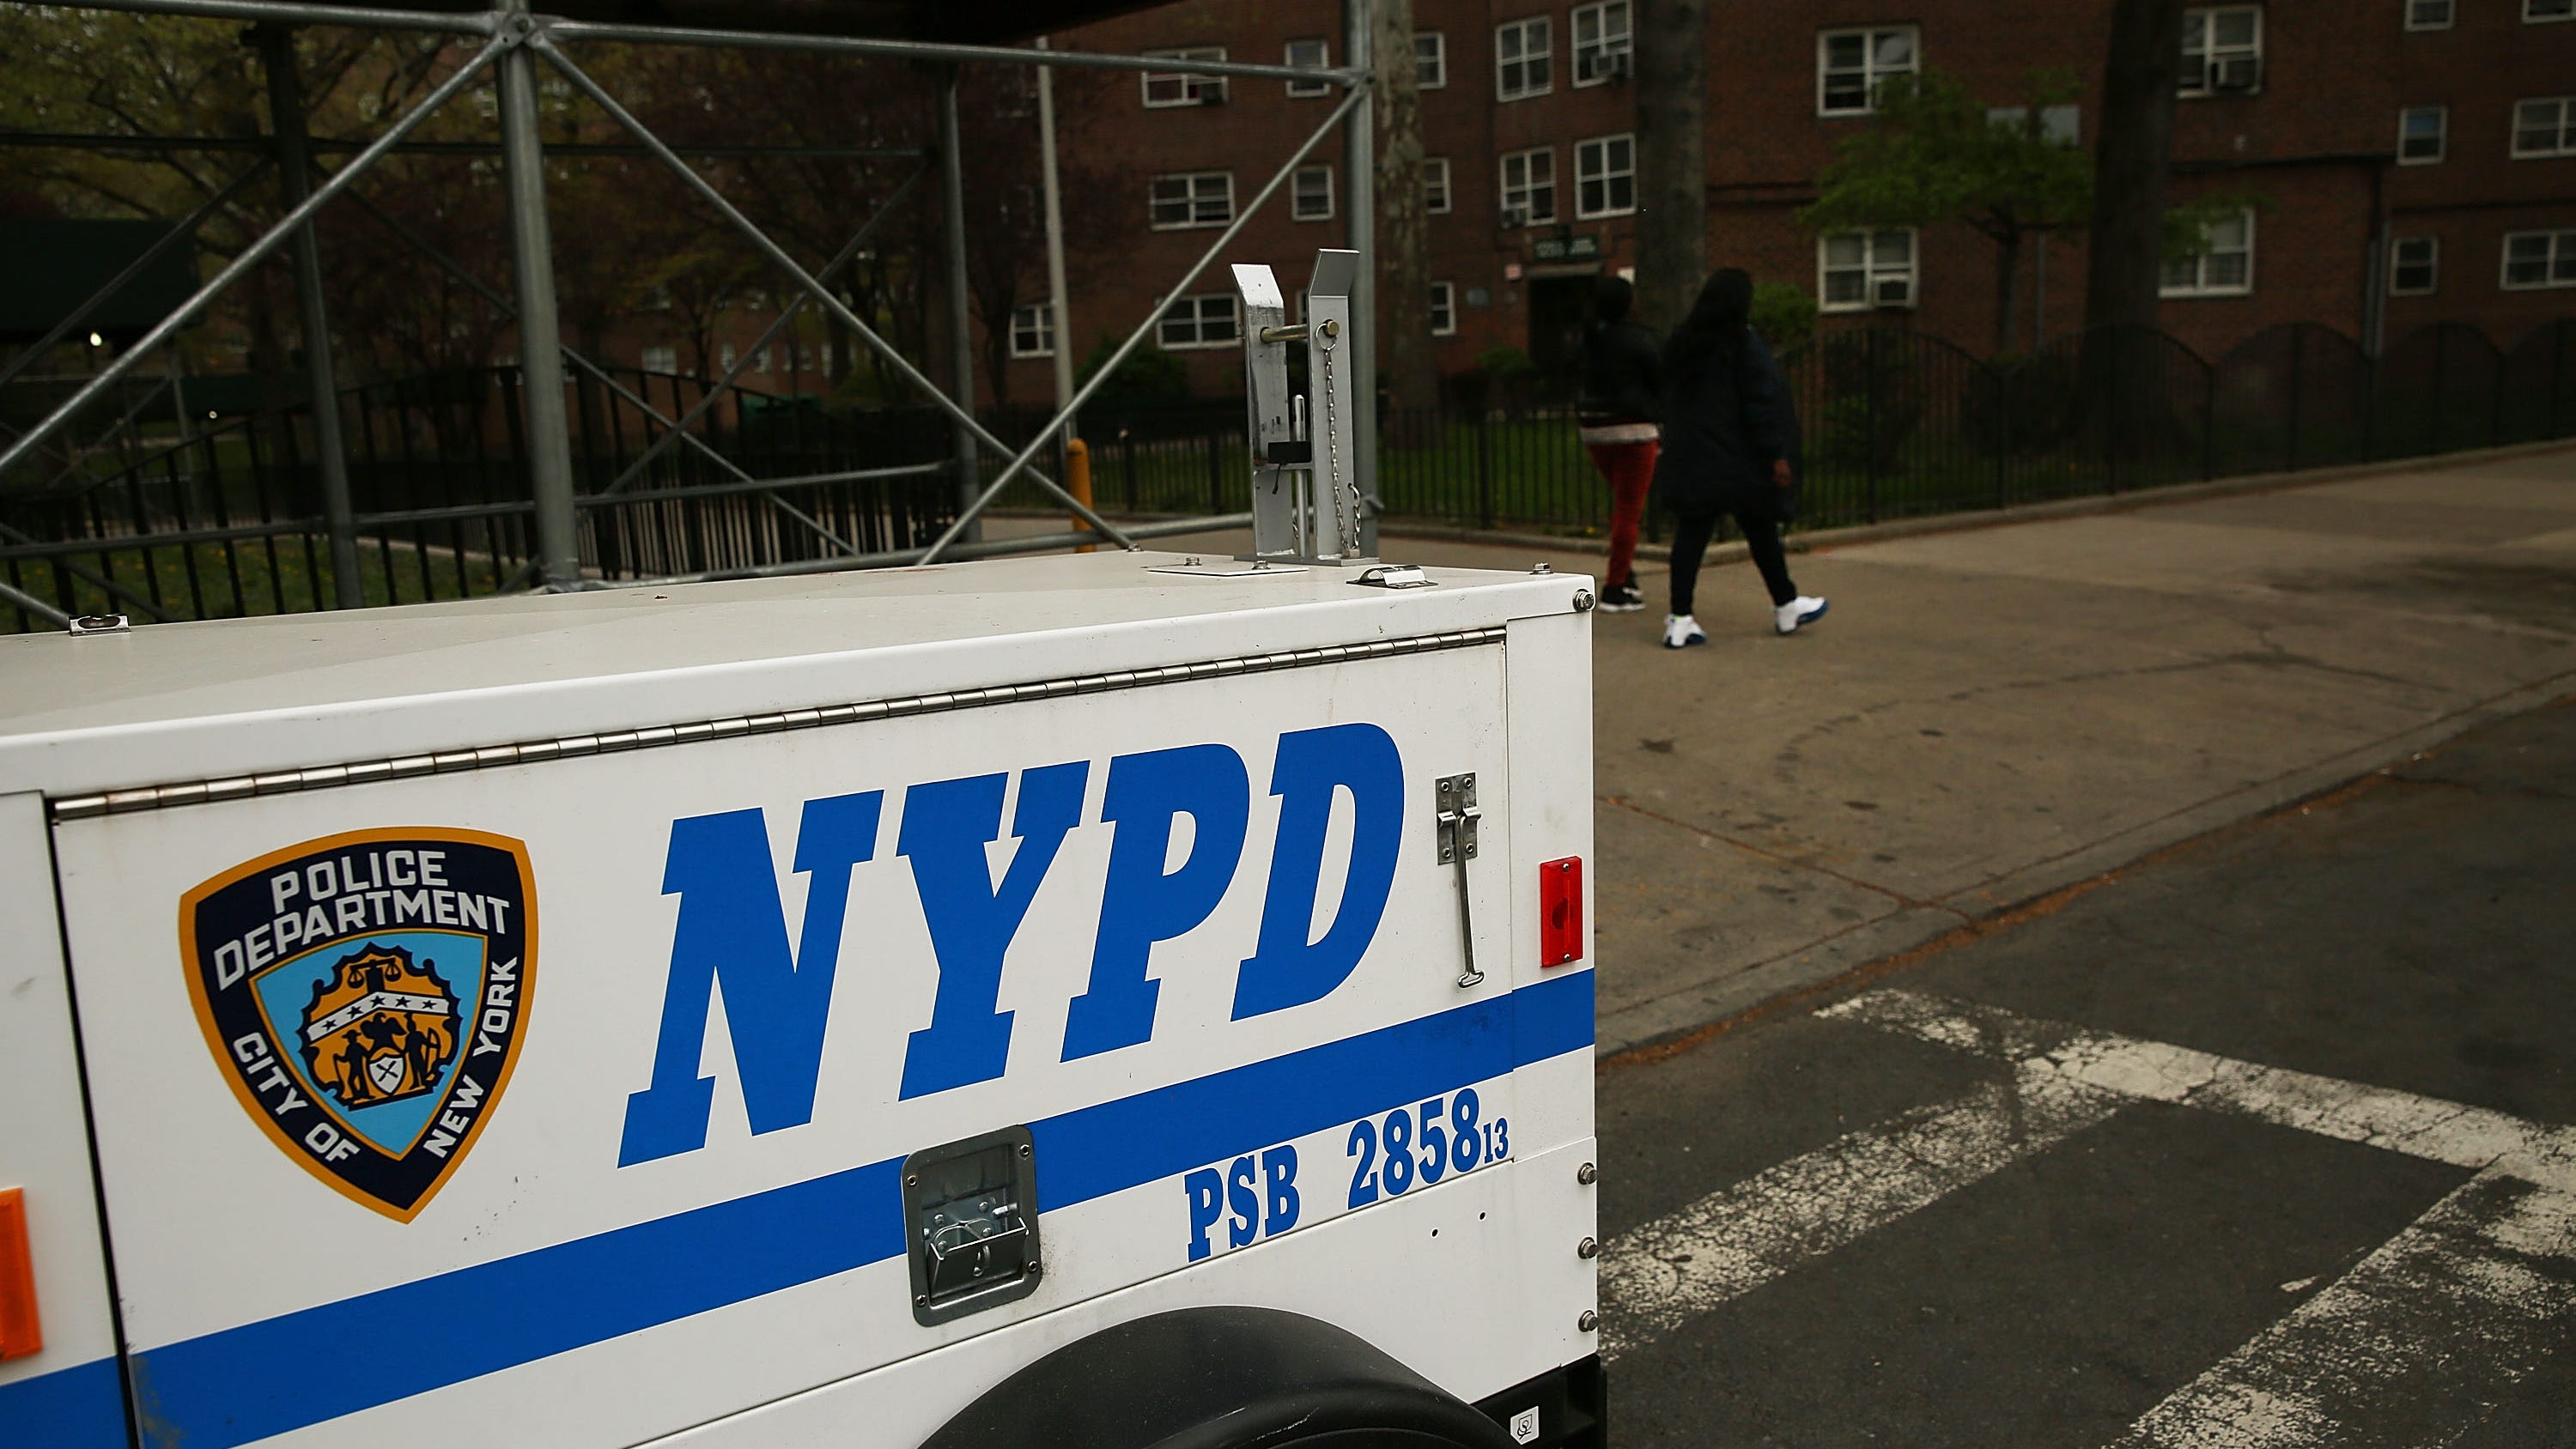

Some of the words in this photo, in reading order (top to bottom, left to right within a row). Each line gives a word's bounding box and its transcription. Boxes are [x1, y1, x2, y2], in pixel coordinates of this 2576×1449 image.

[213, 888, 511, 991] DEPARTMENT
[270, 849, 449, 914] POLICE
[617, 722, 1405, 1168] NYPD
[233, 1031, 309, 1116] CITY
[305, 1121, 361, 1162] OF
[422, 1074, 485, 1159] NEW
[472, 955, 519, 1058] YORK
[1184, 1144, 1300, 1262] PSB
